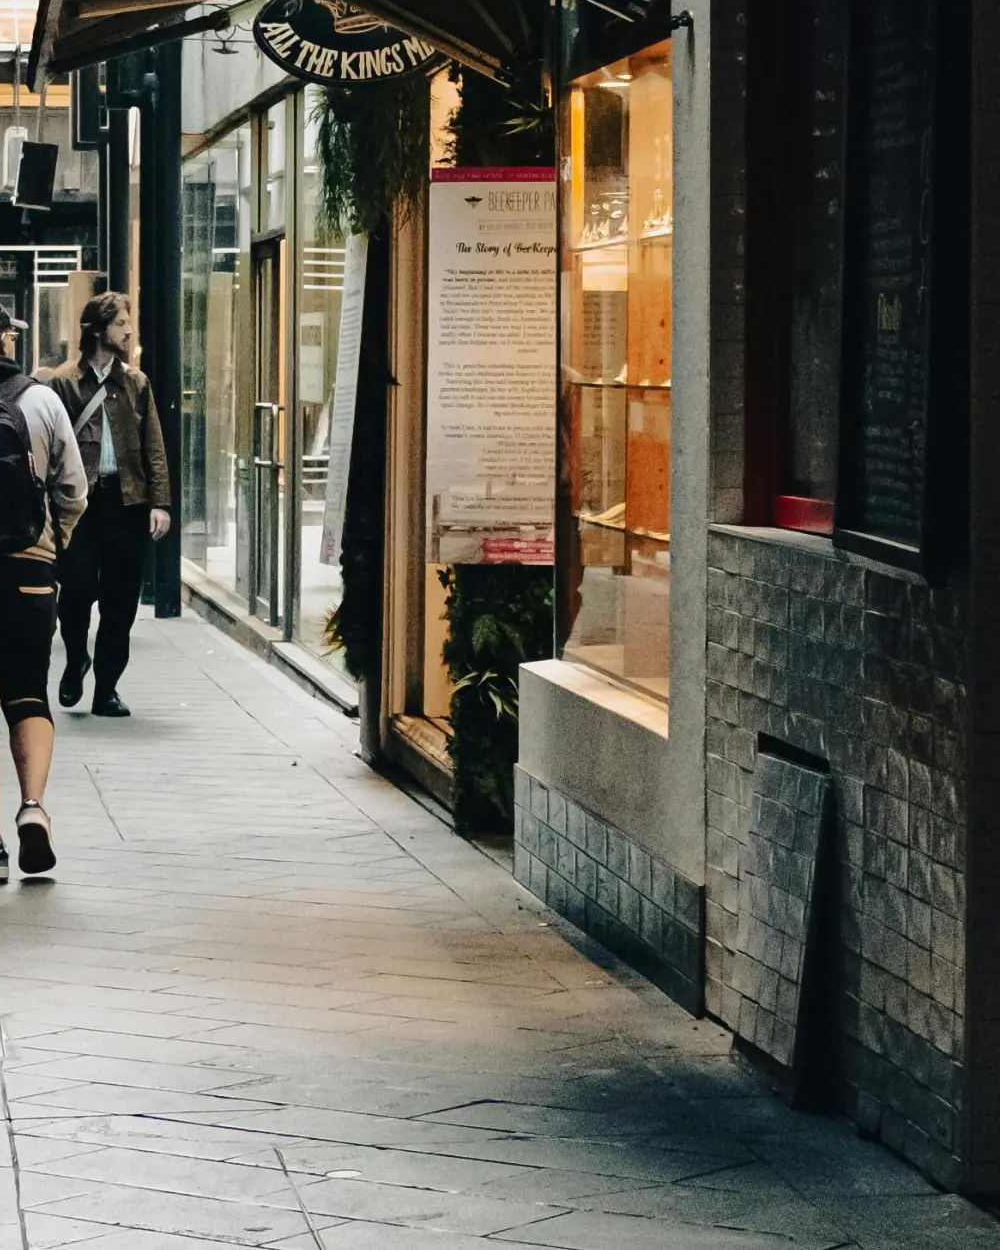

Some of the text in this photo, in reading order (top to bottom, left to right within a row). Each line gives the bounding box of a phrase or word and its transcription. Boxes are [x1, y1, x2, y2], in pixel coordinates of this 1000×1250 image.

[259, 21, 300, 58] ALL
[294, 40, 339, 78] THE
[340, 44, 404, 79] KINGS
[488, 191, 540, 212] BEEKEEPER
[455, 242, 472, 253] The
[475, 242, 500, 258] Story
[502, 242, 513, 257] of
